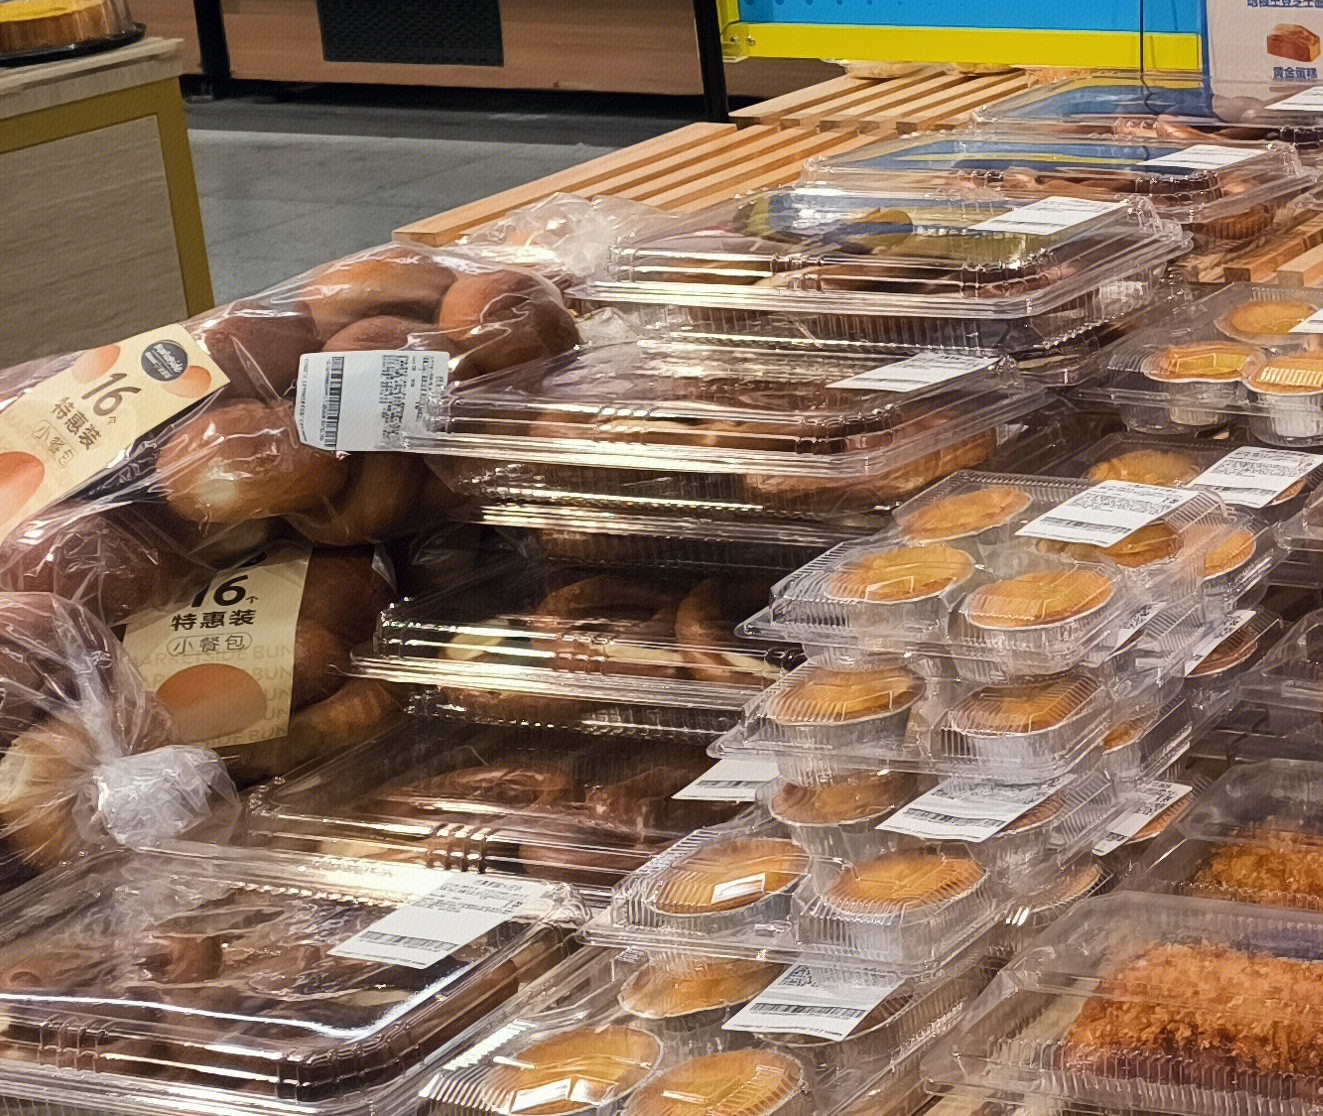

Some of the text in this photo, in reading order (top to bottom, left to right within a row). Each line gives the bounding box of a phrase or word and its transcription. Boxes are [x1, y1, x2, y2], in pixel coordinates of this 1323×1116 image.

[81, 373, 141, 416] 16
[51, 396, 101, 450] 特惠装
[34, 424, 75, 467] 小餐包
[171, 609, 256, 631] 特惠装
[173, 634, 245, 655] 小餐包
